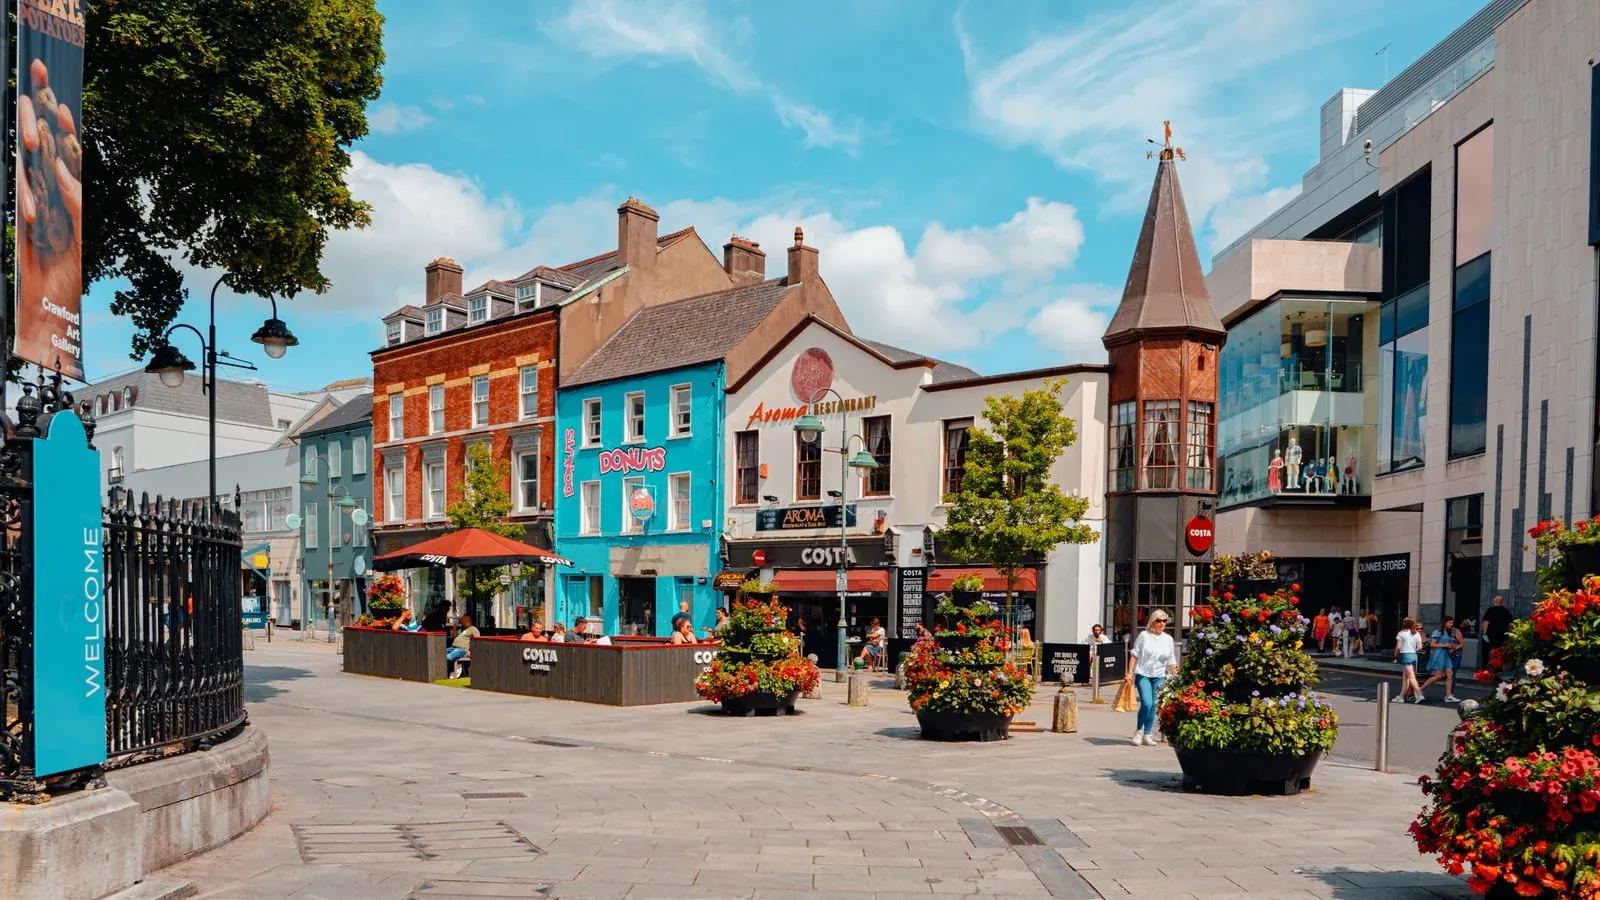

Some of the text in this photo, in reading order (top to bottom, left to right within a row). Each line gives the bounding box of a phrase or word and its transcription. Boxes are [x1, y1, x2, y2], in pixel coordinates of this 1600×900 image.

[42, 296, 80, 326] Crawford
[66, 325, 80, 341] Art
[51, 334, 81, 359] Gallery
[745, 396, 877, 430] Aroma RESTAURANT
[564, 428, 575, 498] DONUTS
[599, 447, 667, 475] DONUTS
[784, 508, 825, 522] AROMA
[1190, 529, 1211, 537] COSTA
[420, 554, 447, 565] COSTA
[801, 547, 857, 566] COSTA
[903, 569, 922, 577] COSTA
[1382, 559, 1407, 571] STORES
[83, 527, 101, 698] WELCOME
[523, 648, 558, 663] COSTA
[1053, 665, 1077, 674] COFFEE
